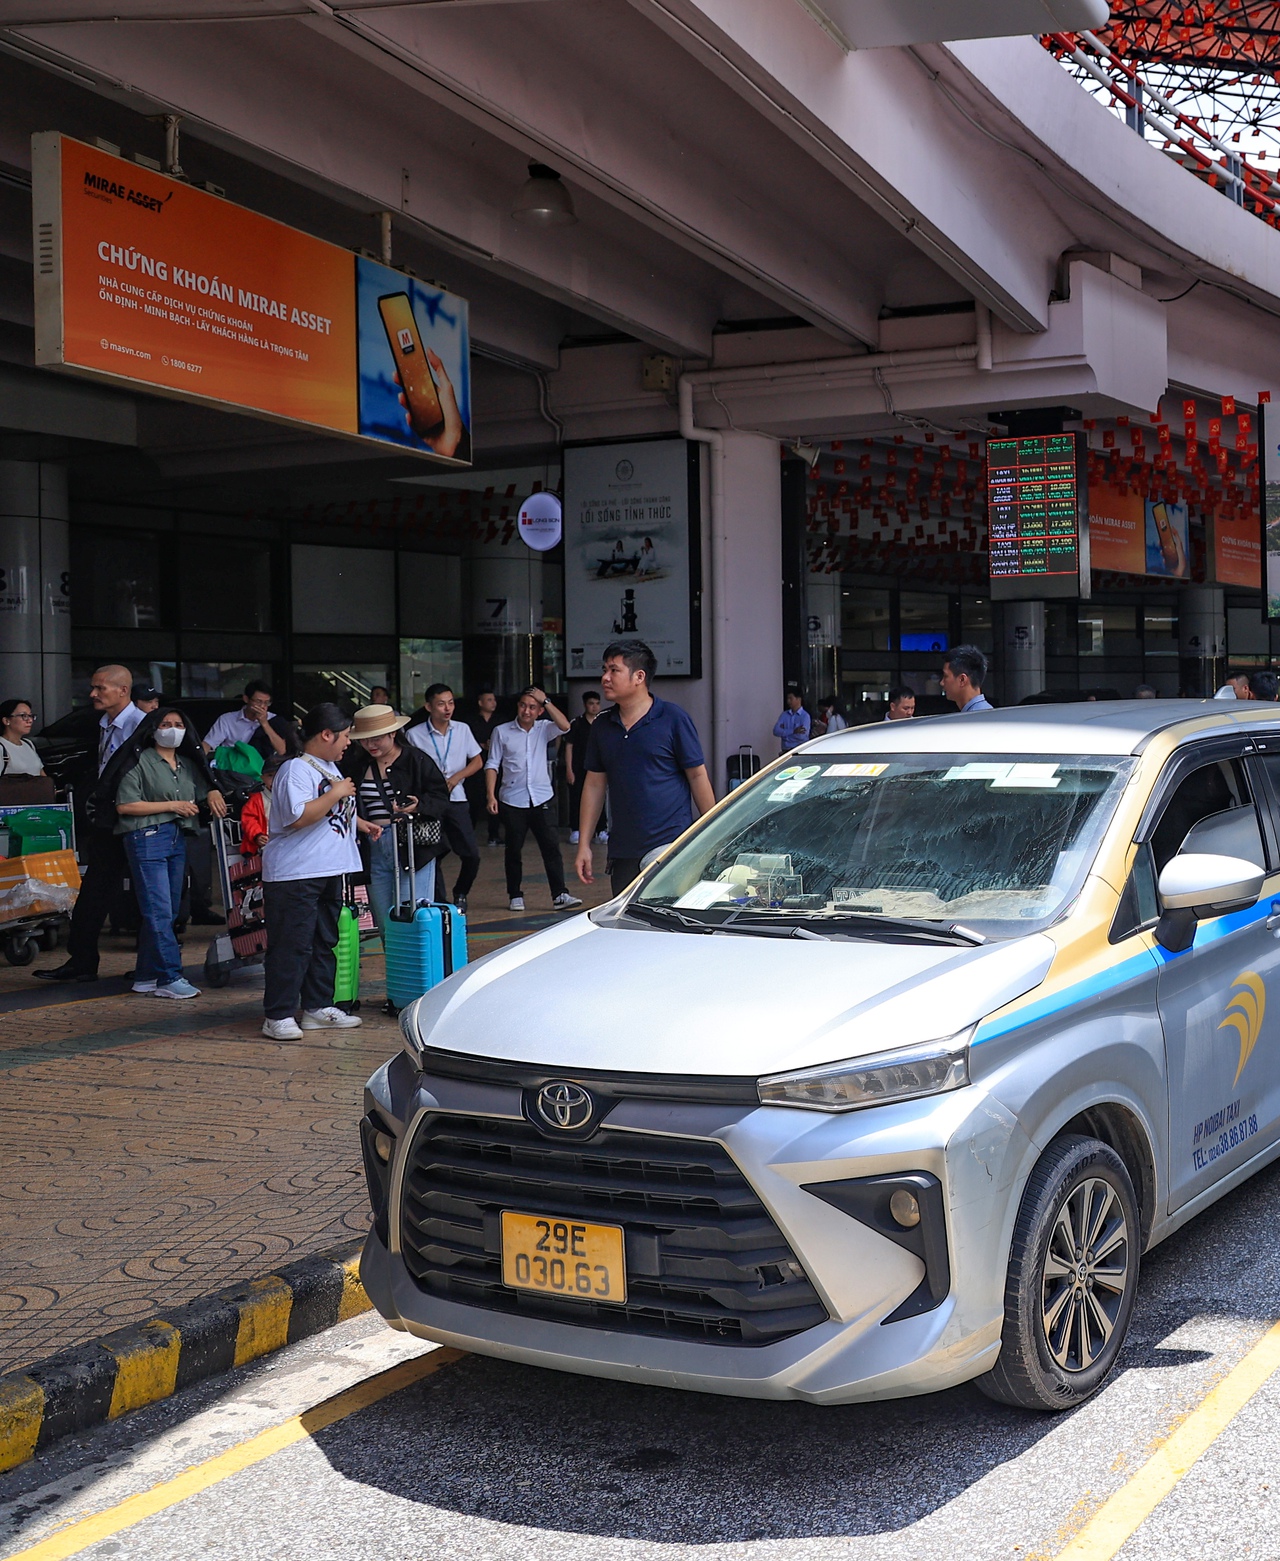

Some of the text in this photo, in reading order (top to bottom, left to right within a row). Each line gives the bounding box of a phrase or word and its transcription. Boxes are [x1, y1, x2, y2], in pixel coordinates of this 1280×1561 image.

[83, 171, 164, 213] MIRAE ASSET
[97, 241, 332, 335] CHỨNG KHOÁN MIRAE ASSET
[98, 275, 253, 332] NHÀ CUNG CẤP DỊCH VỤ CHỨNG KHOÁN
[114, 294, 138, 310] ĐỊNH
[144, 304, 168, 319] MINH
[169, 311, 191, 326] BẠCH
[211, 324, 237, 340] KHÁCH
[238, 332, 259, 347] HÀNG
[260, 338, 270, 351] LÀ
[270, 342, 294, 357] TRỌNG
[294, 349, 309, 362] TÂM
[109, 343, 152, 360] masvn.com
[170, 358, 203, 374] 1800 6277
[580, 508, 594, 524] LỐI
[597, 507, 621, 523] SỐNG
[486, 599, 507, 618] 7
[807, 615, 822, 631] 6
[1014, 625, 1029, 640] 5
[1189, 635, 1201, 647] 4
[1193, 1122, 1204, 1146] HP
[1226, 1098, 1241, 1125] TAXI
[535, 1220, 586, 1257] 29E
[515, 1253, 611, 1297] 030.63
